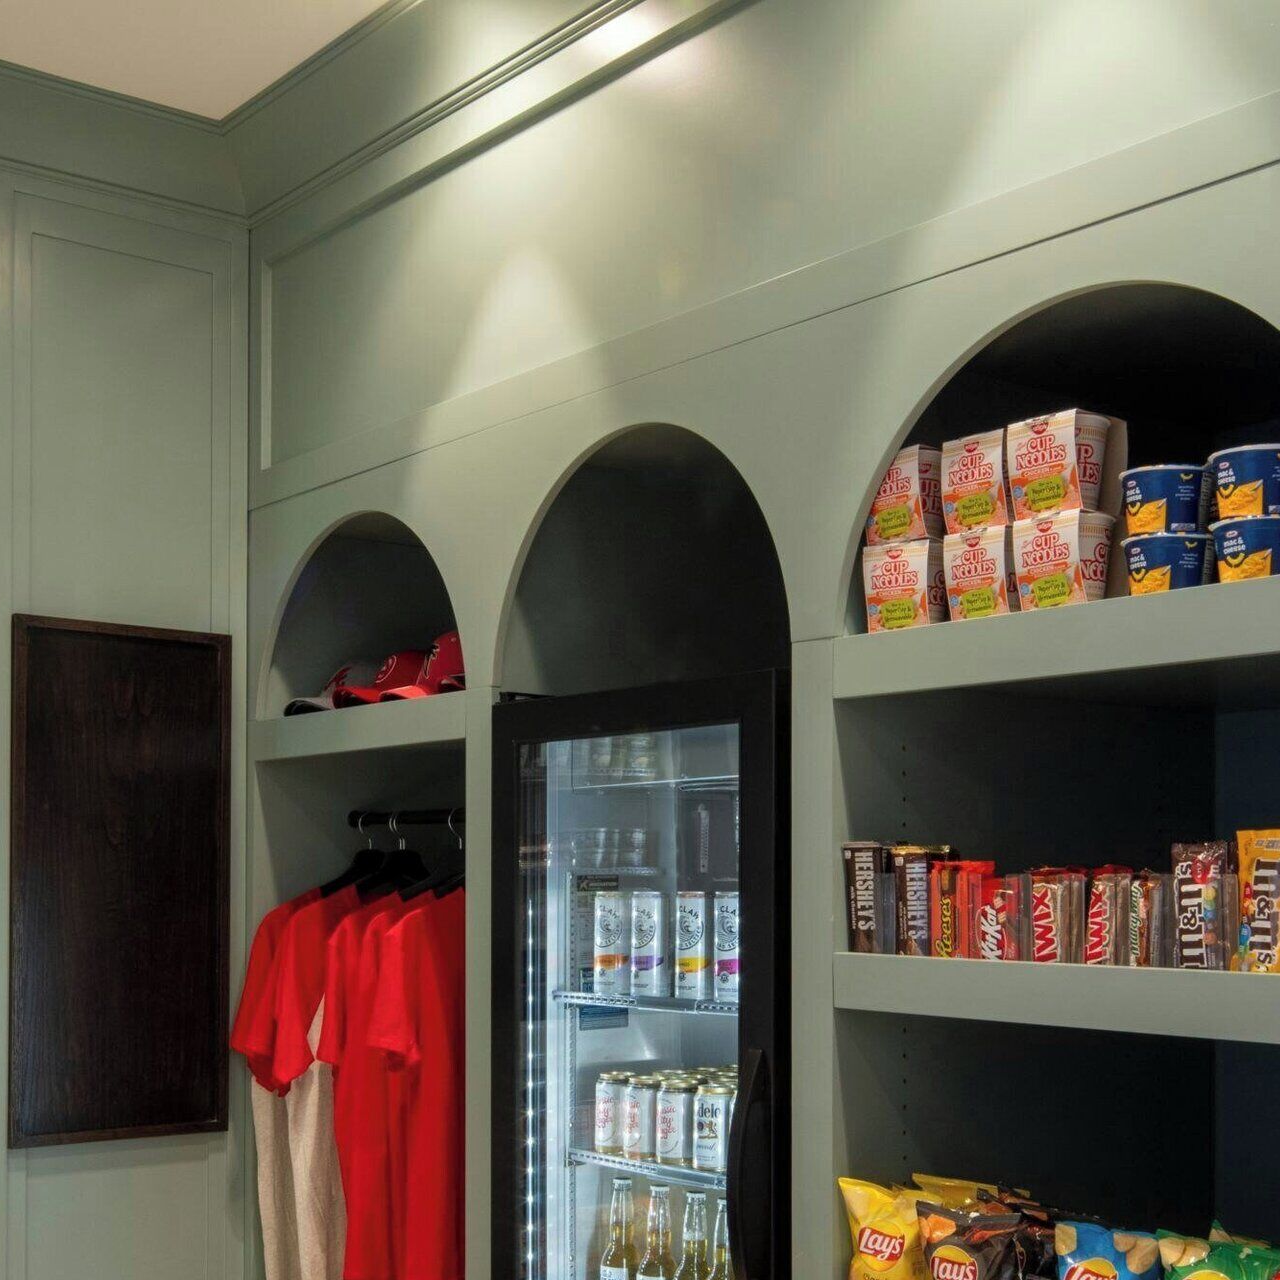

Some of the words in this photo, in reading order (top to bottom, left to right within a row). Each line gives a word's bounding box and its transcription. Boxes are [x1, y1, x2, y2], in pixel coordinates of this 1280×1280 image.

[1027, 434, 1055, 452] CUP
[959, 453, 984, 469] CUP
[1016, 444, 1067, 471] NOODLES
[886, 468, 902, 482] UP
[948, 462, 994, 486] NOODLES
[1032, 533, 1060, 550] CUP
[1223, 539, 1238, 548] mac
[961, 548, 987, 564] CUP
[1022, 543, 1069, 568] NOODLES
[881, 560, 909, 575] CUP
[951, 559, 996, 580] NOODLES
[871, 571, 918, 589] NOODLES
[720, 905, 737, 915] CLA
[859, 1226, 905, 1261] Lay's
